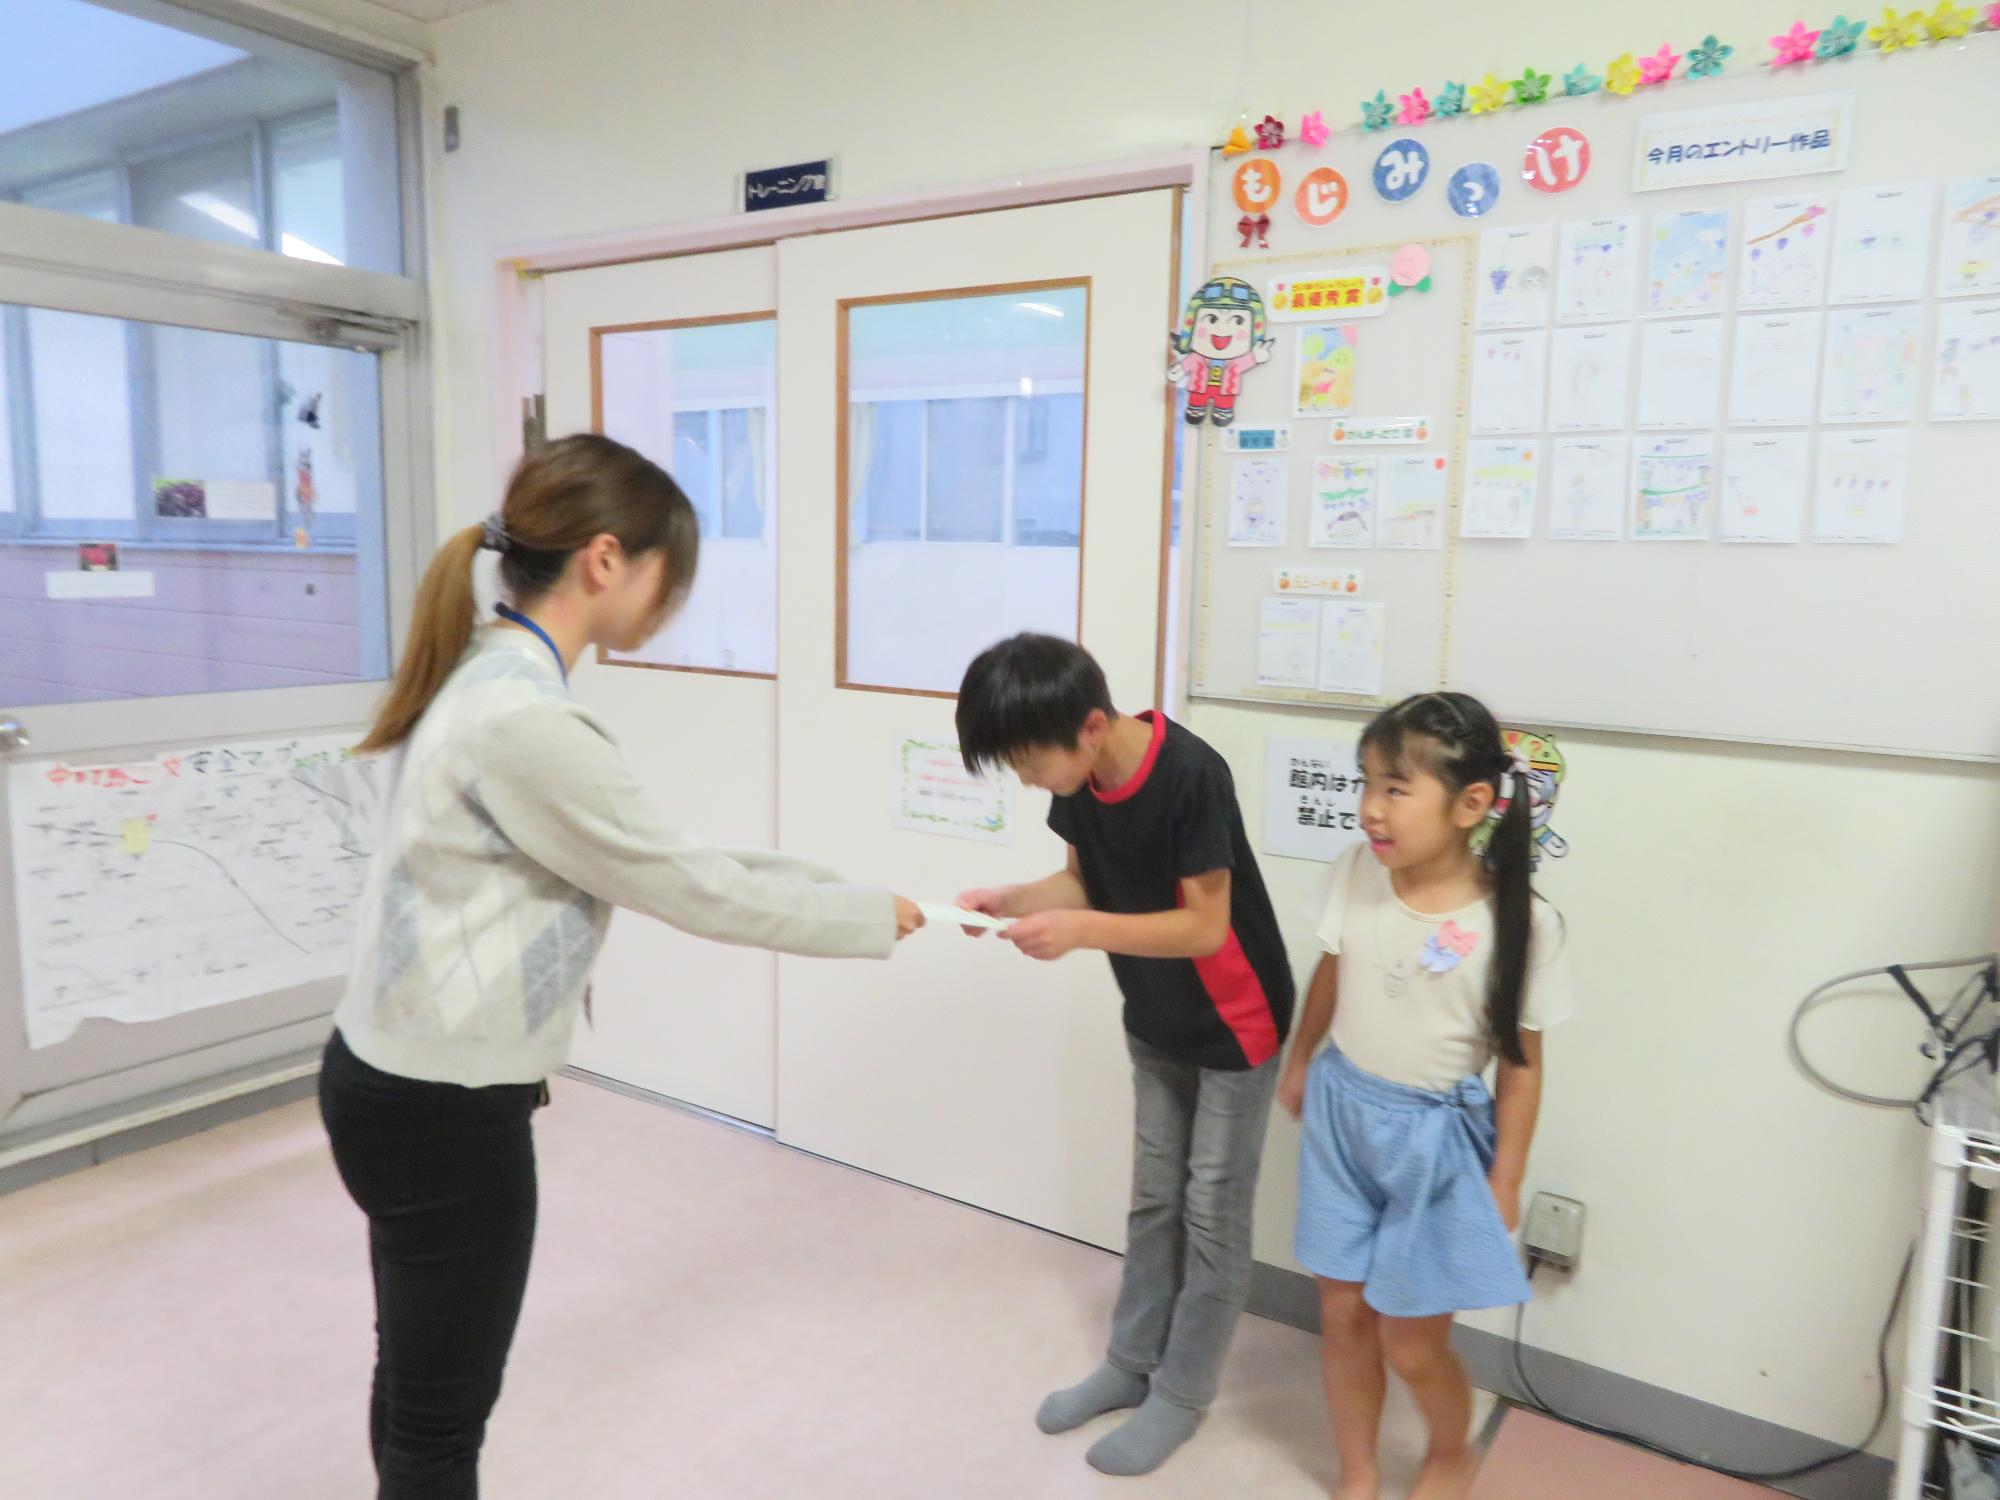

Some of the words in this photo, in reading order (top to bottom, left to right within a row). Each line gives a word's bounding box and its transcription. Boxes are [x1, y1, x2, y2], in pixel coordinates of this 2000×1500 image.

[1647, 129, 1831, 165] 今月のエントリー作品
